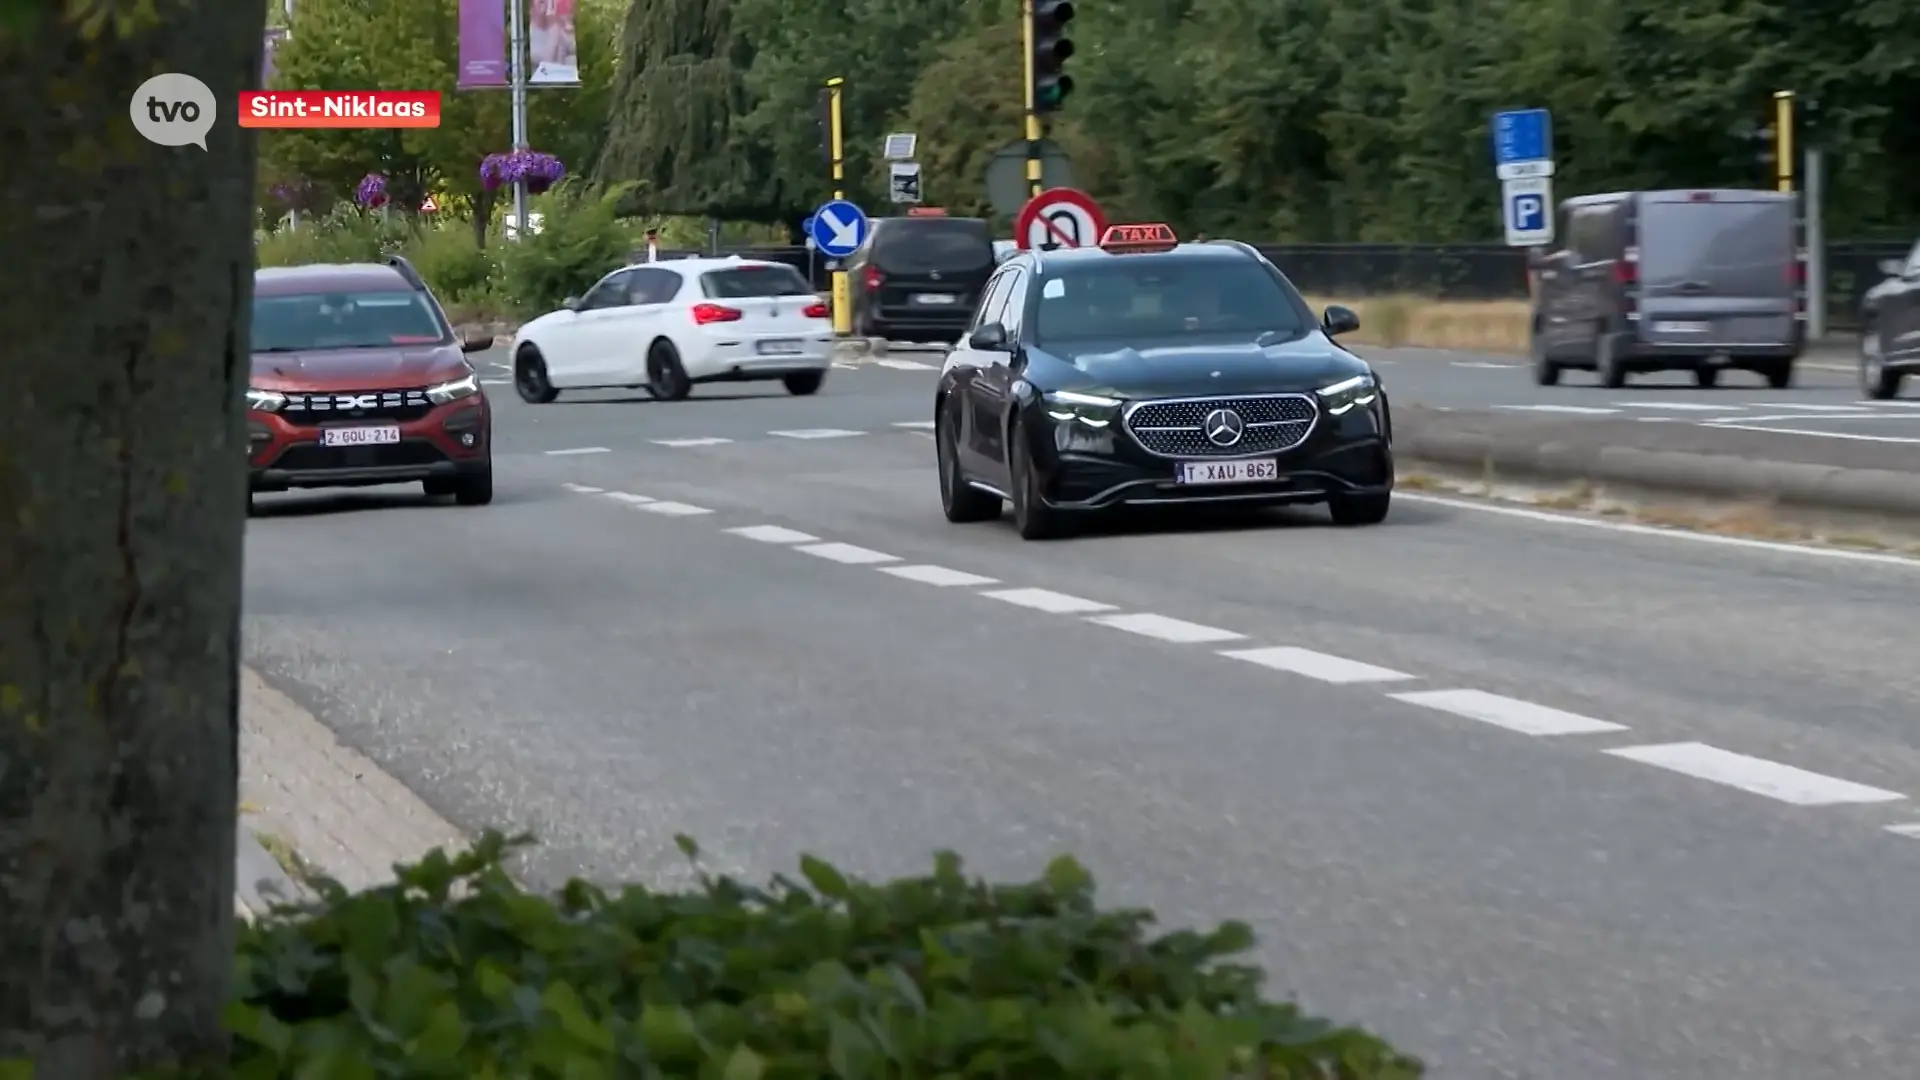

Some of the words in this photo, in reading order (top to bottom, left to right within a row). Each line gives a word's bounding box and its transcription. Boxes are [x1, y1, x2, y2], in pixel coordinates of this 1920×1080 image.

[1517, 198, 1541, 229] P
[1120, 227, 1161, 241] TAXI
[1186, 463, 1276, 481] T-XAU-862
